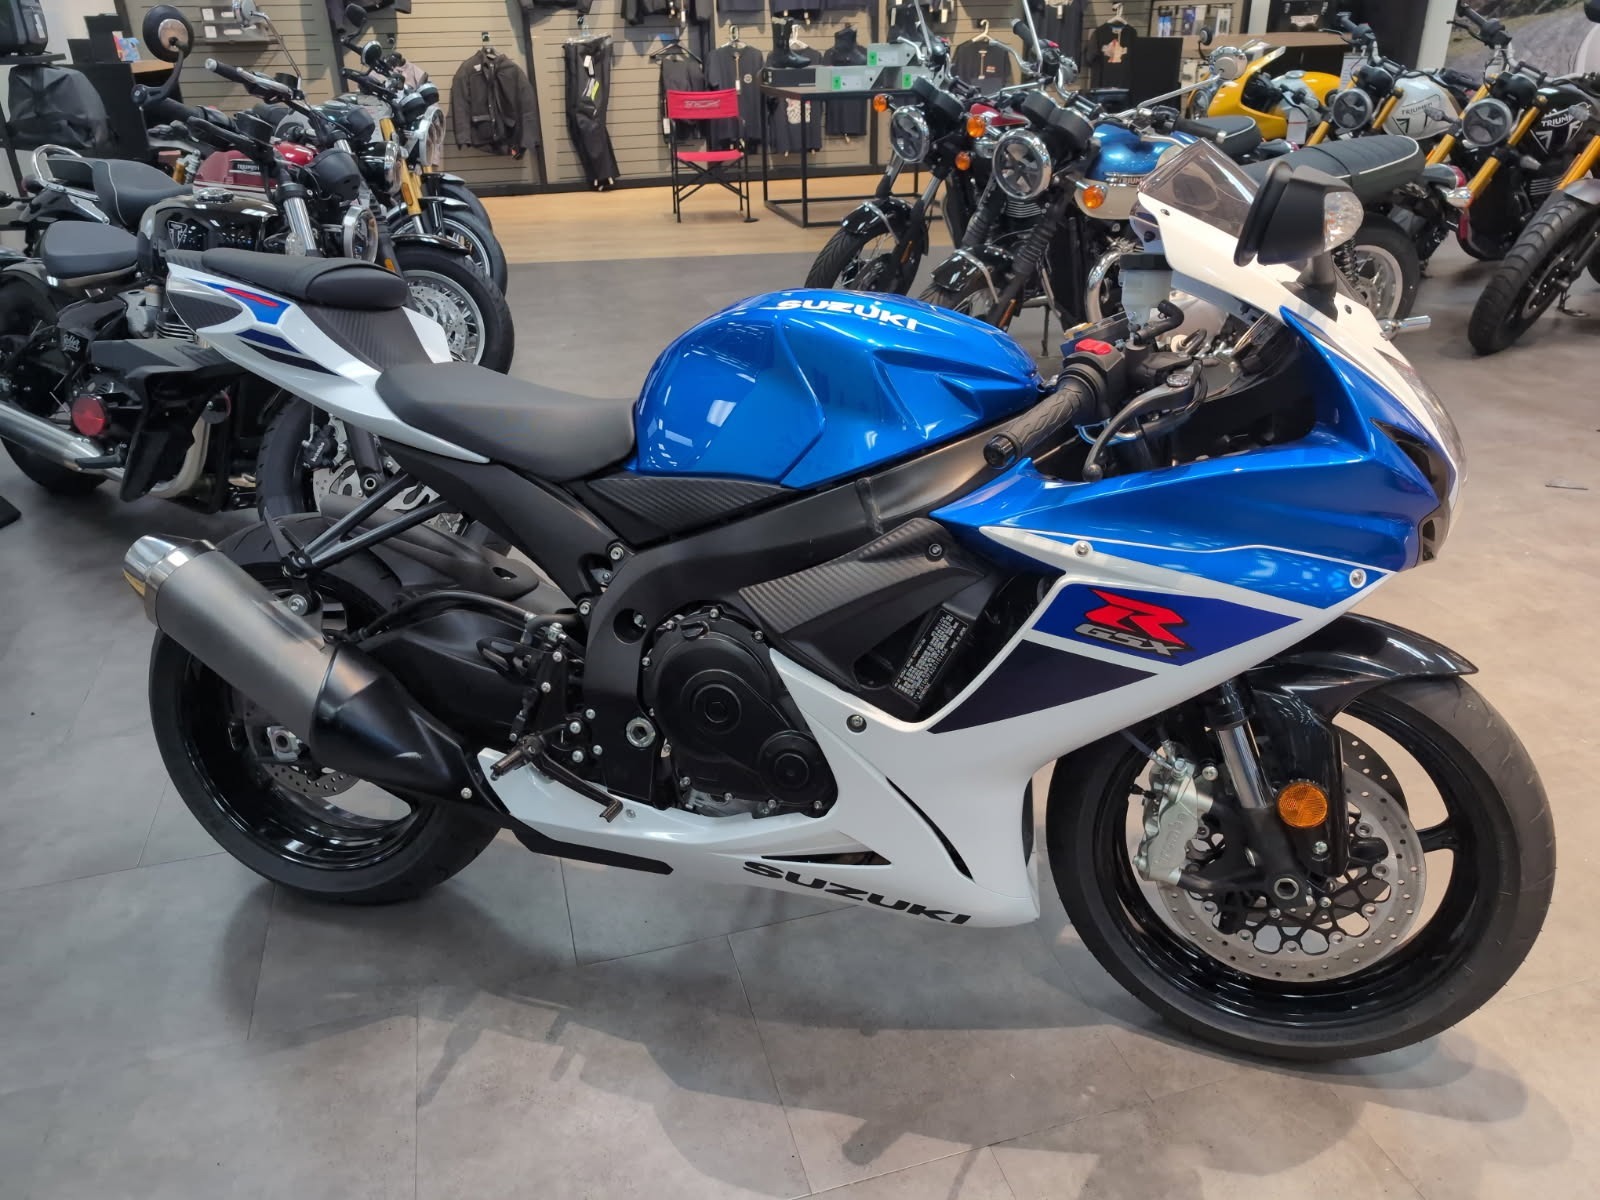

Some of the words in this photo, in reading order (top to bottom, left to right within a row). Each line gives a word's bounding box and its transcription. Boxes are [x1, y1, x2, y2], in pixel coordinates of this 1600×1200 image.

[1541, 112, 1575, 127] TRIUMP
[777, 300, 918, 331] SUZUKI
[1074, 623, 1185, 657] GSX
[743, 861, 972, 925] SUZUKI
